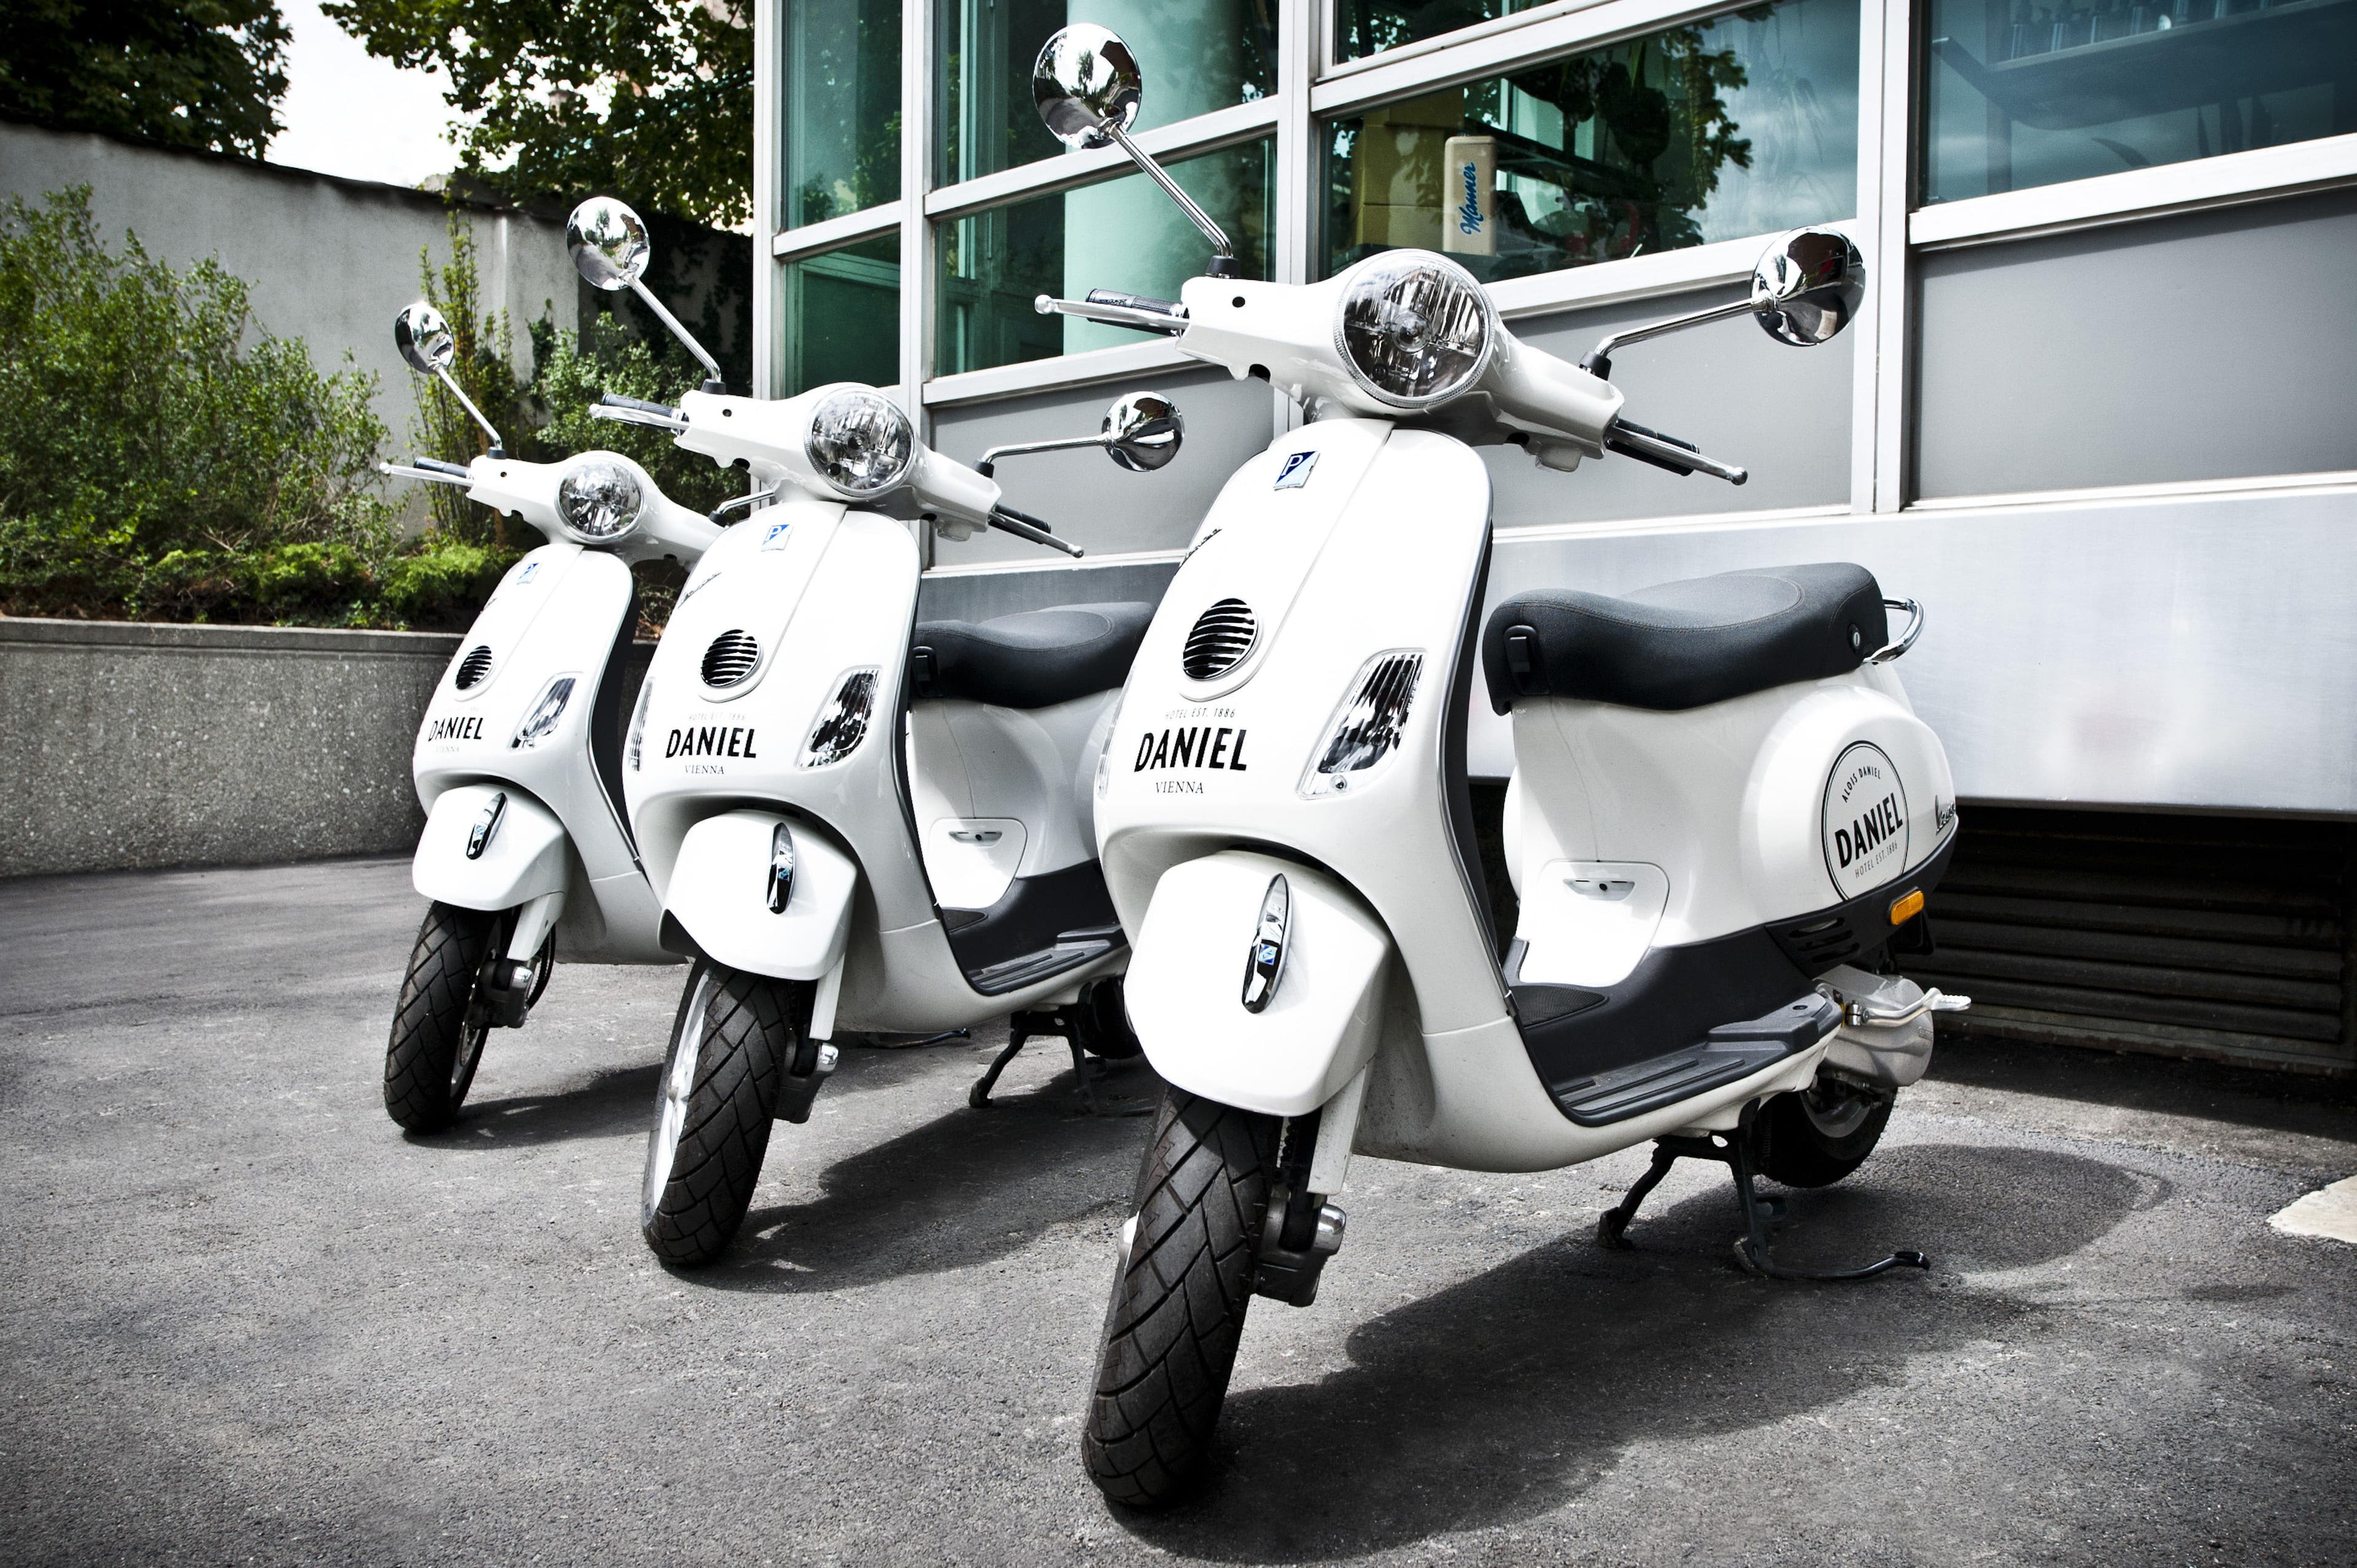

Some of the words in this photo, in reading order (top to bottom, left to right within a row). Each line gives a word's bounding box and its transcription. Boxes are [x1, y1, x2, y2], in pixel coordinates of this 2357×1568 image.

[1458, 161, 1484, 235] Manner
[1213, 708, 1236, 718] 1886
[428, 717, 483, 741] DANIEL
[665, 727, 756, 758] DANIEL
[1134, 727, 1247, 772] DANIEL
[684, 765, 724, 774] VIENNA
[1156, 781, 1204, 794] VIENNA
[1841, 773, 1858, 803] ALOIS
[1858, 765, 1881, 780] DANIEL
[1835, 792, 1903, 869] DANIEL
[1855, 859, 1874, 879] HOTEL
